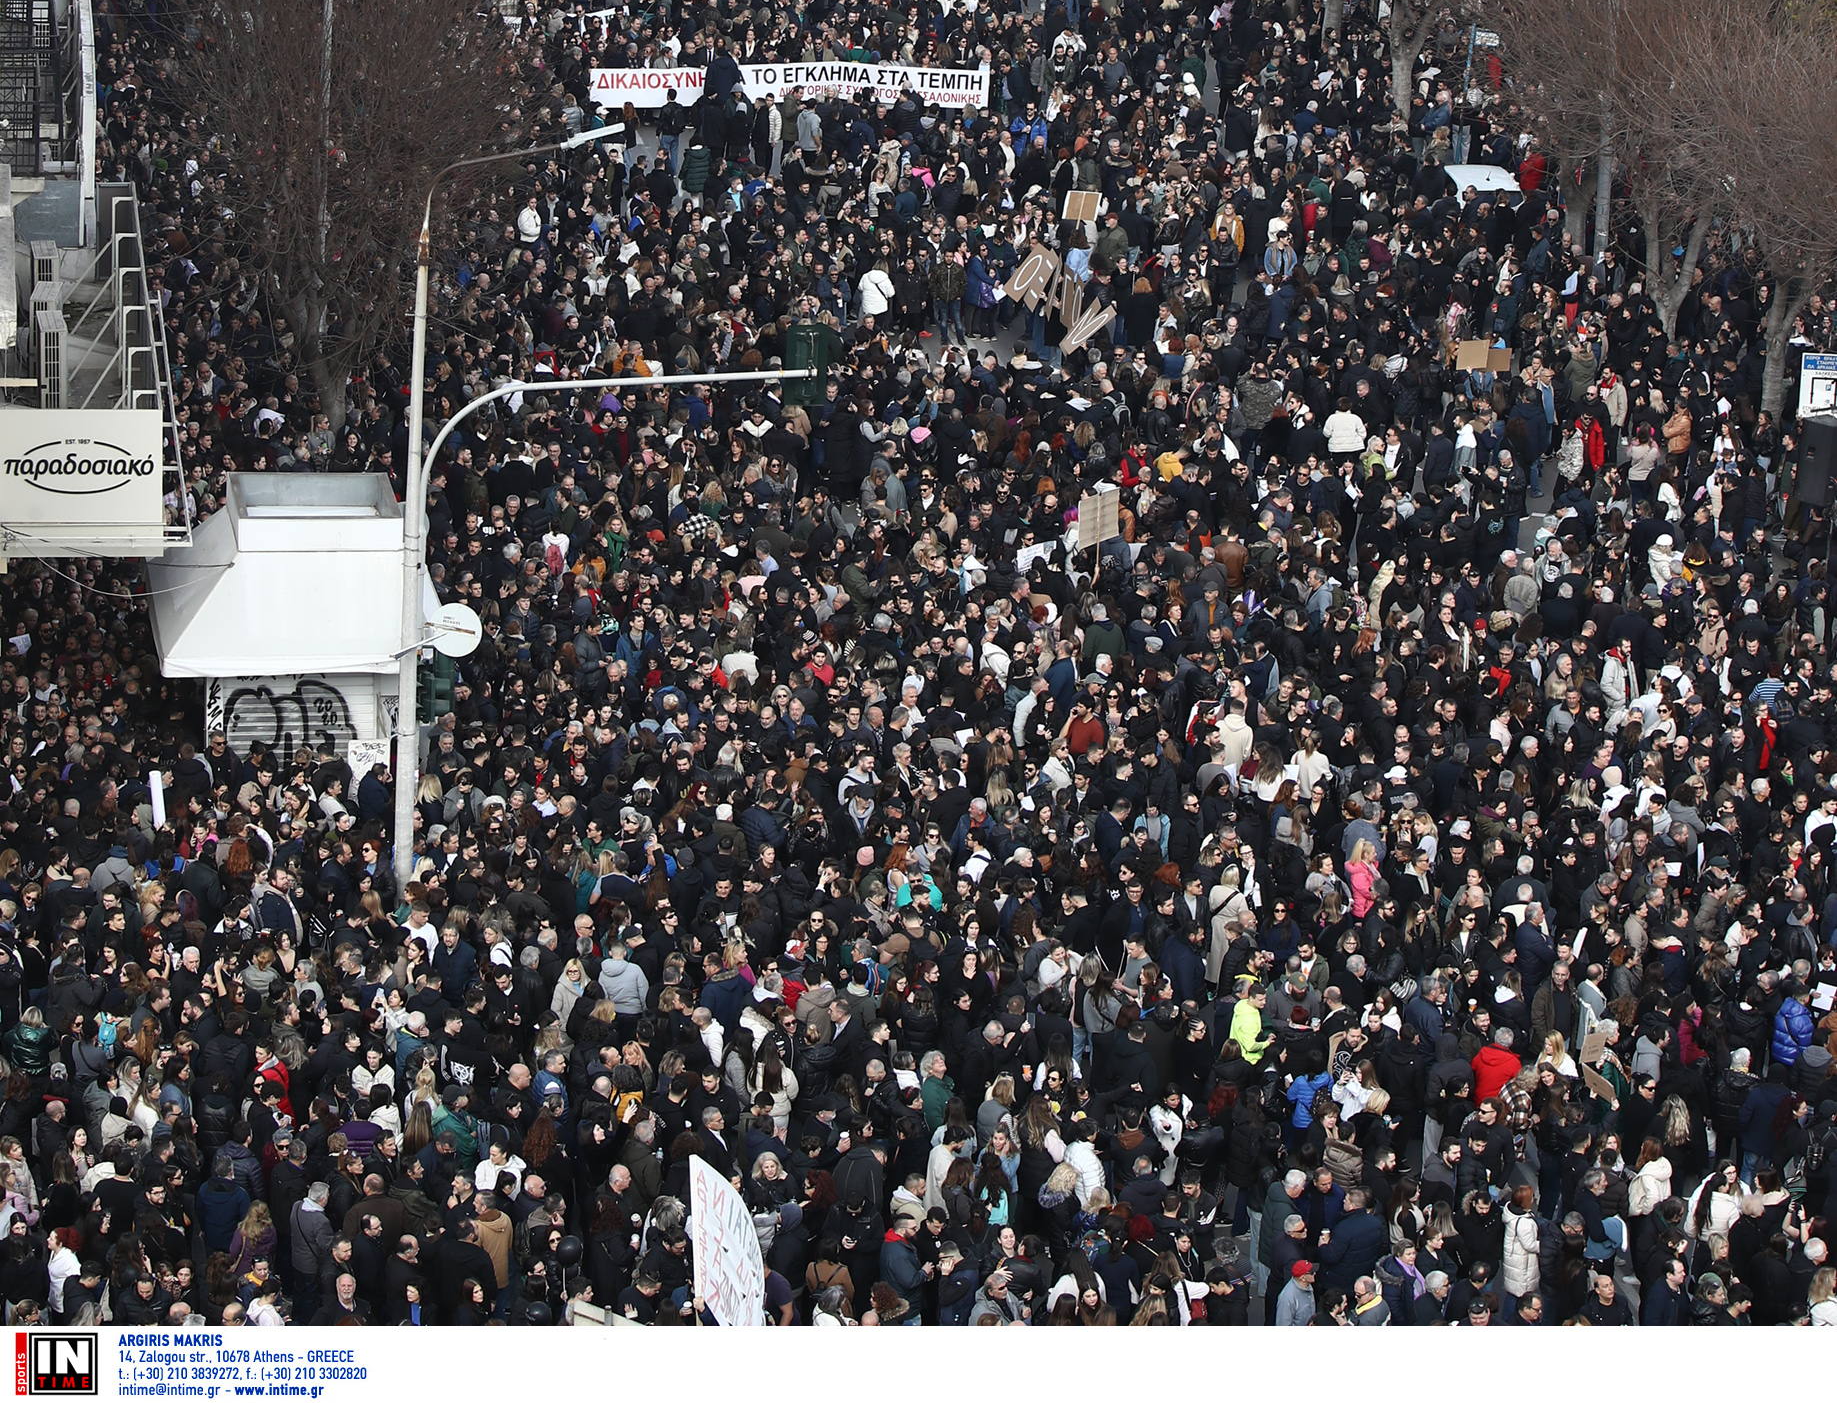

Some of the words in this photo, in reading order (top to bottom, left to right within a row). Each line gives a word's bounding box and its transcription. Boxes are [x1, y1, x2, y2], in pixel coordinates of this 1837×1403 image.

[752, 68, 777, 85] ΤΟ
[783, 66, 871, 84] ΕΓΚΛΗΜΑ
[917, 72, 983, 91] ΤΕΜΠΗ
[4, 452, 155, 481] παραδοσιακό
